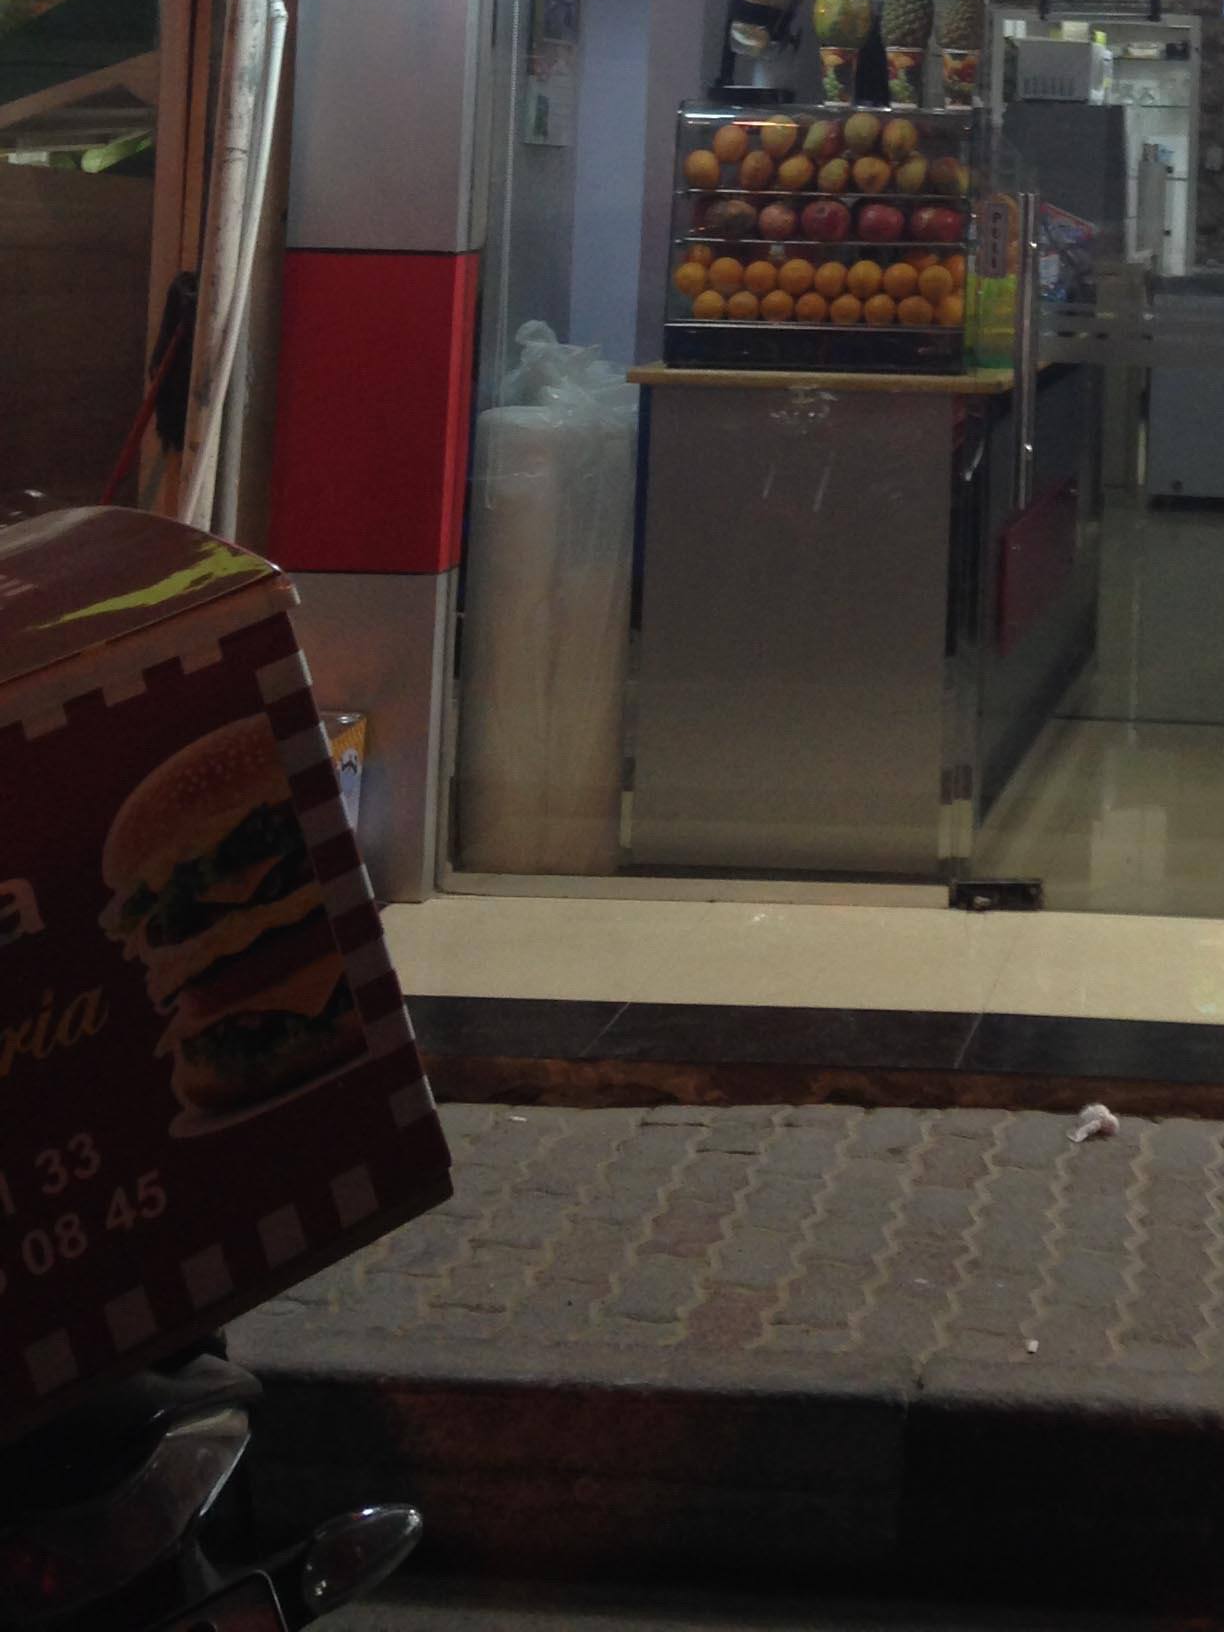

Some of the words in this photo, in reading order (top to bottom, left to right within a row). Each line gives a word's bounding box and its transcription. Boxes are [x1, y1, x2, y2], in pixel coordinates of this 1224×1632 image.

[34, 1132, 102, 1196] 33
[21, 1212, 88, 1276] 08
[105, 1168, 168, 1232] 45
